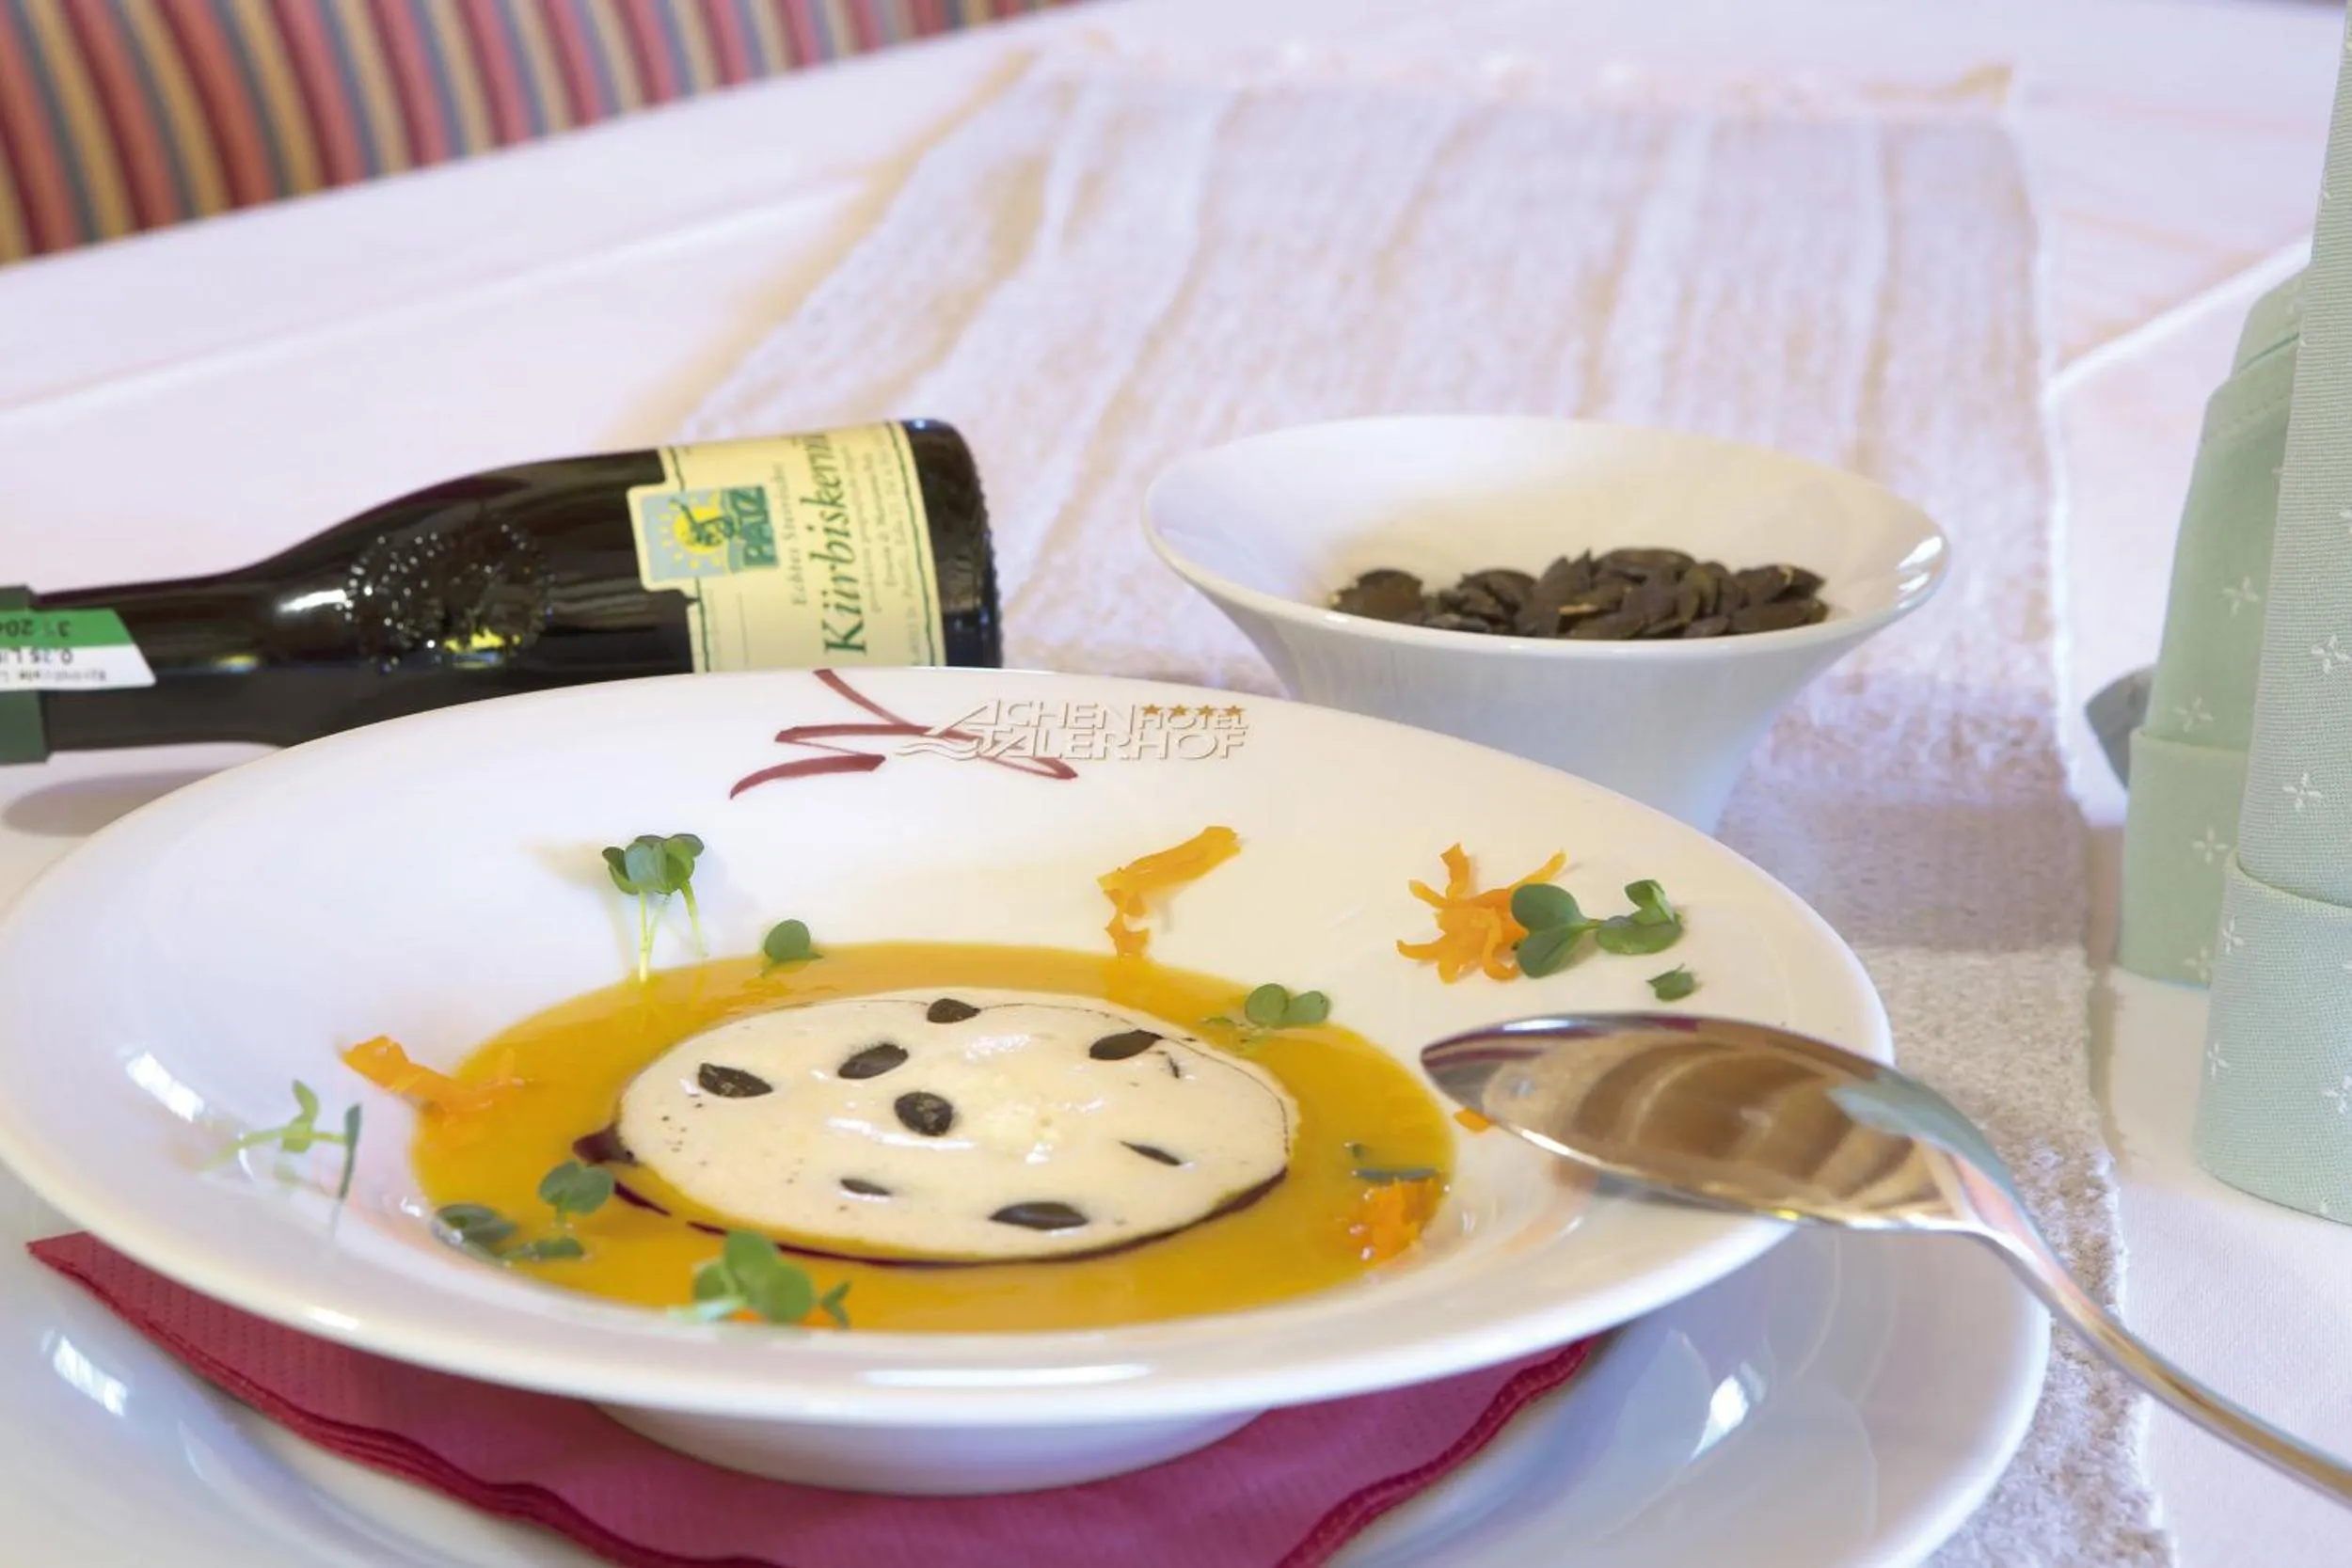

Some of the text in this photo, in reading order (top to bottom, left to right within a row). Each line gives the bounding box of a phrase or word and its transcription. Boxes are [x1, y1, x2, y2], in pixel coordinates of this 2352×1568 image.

[728, 486, 778, 567] PATZ
[920, 699, 1136, 738] ACHEN
[1138, 710, 1249, 730] HOTEL
